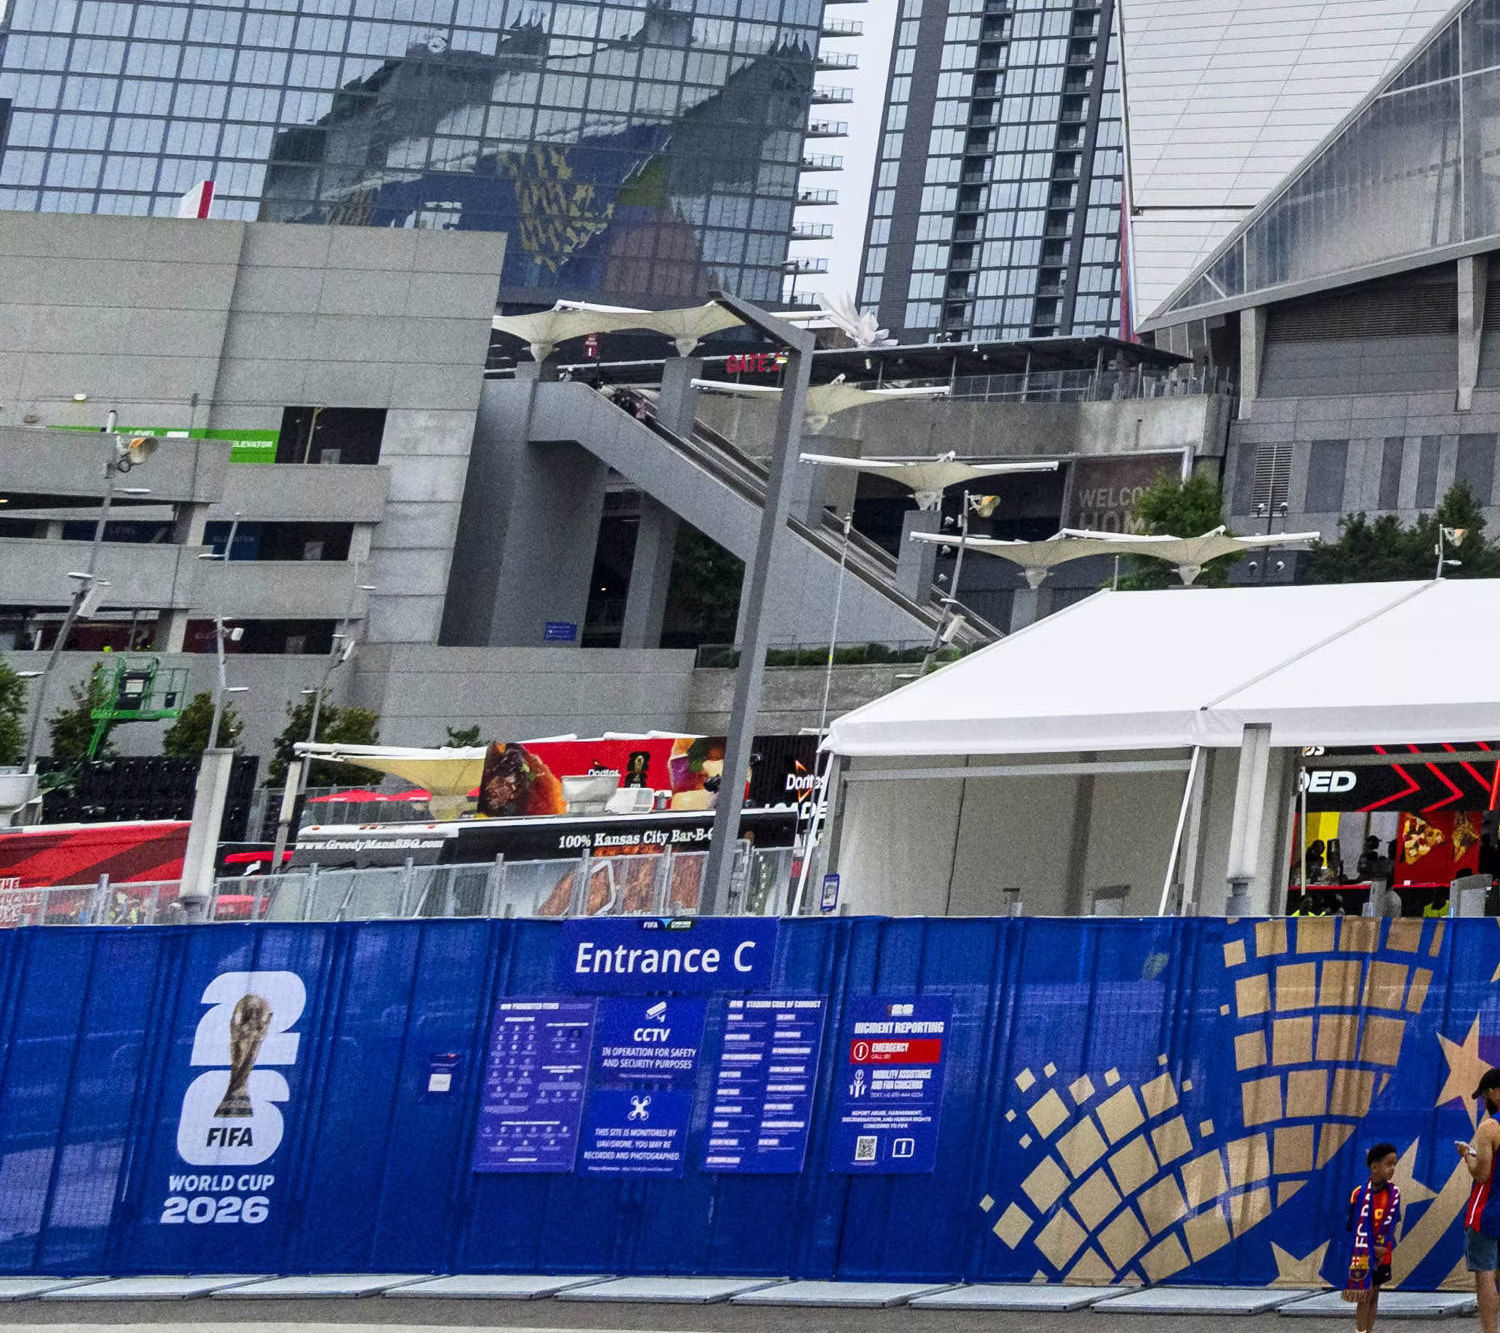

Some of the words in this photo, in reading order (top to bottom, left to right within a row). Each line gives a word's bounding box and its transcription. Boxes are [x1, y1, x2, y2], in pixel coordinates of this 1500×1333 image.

[1079, 486, 1149, 508] WELCO
[558, 835, 592, 848] 100%
[593, 833, 641, 847] Kansas
[643, 830, 670, 846] City
[575, 942, 720, 974] Entrance
[734, 940, 757, 972] C
[634, 1028, 670, 1042] CCTV
[854, 1022, 894, 1034] INCIDENT
[894, 1022, 944, 1034] REPORTING
[602, 1047, 611, 1056] IN
[612, 1047, 653, 1057] OPERATION
[654, 1048, 669, 1057] FOR
[670, 1048, 696, 1057] SAFETY
[602, 1059, 619, 1068] AND
[620, 1059, 654, 1068] SECURITY
[655, 1059, 693, 1069] PURPOSES
[206, 1127, 254, 1148] FIFA
[168, 1174, 234, 1192] WORLD
[237, 1174, 275, 1192] CUP
[160, 1196, 270, 1224] 2026
